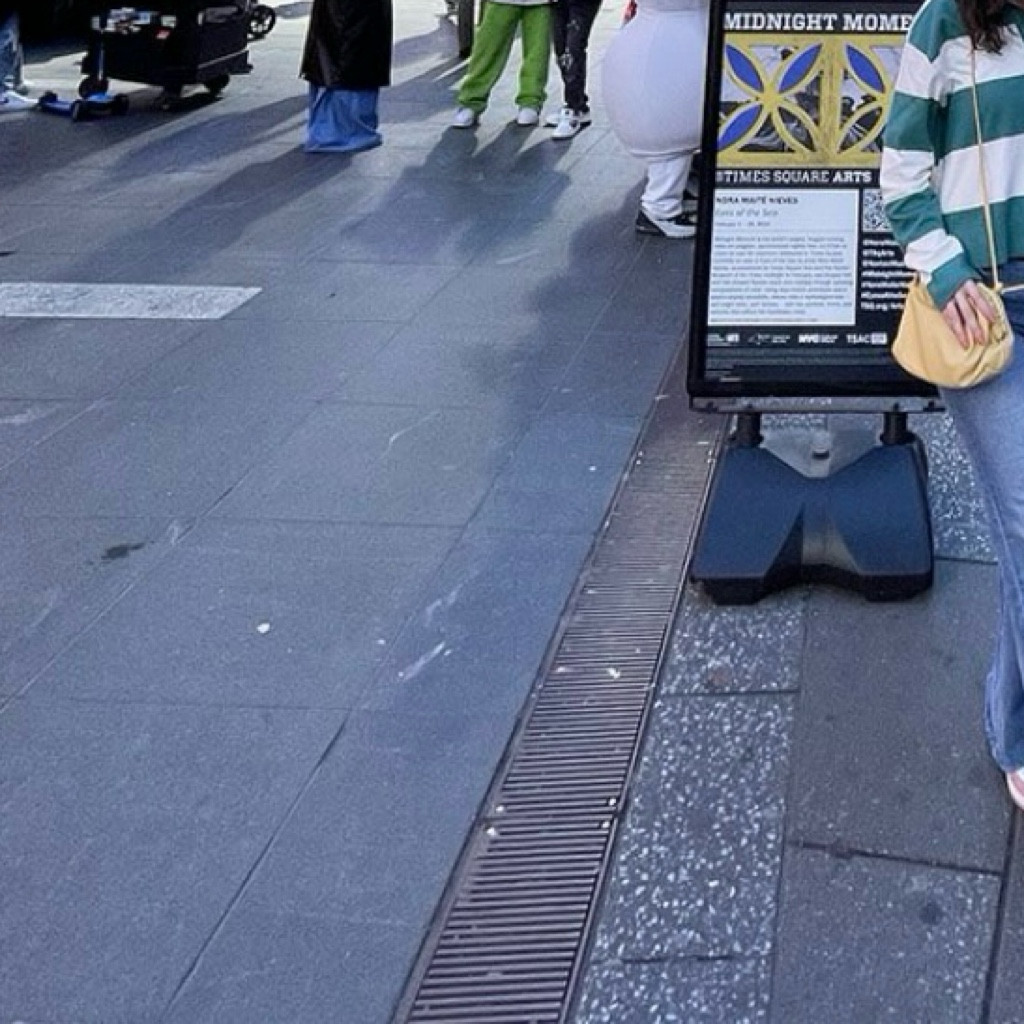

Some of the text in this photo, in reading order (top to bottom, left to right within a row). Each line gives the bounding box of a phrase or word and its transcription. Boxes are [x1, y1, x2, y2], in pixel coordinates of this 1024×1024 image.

[724, 12, 914, 31] MIDNIGHT MOME
[725, 169, 872, 183] TIMES SQUARE ARTS
